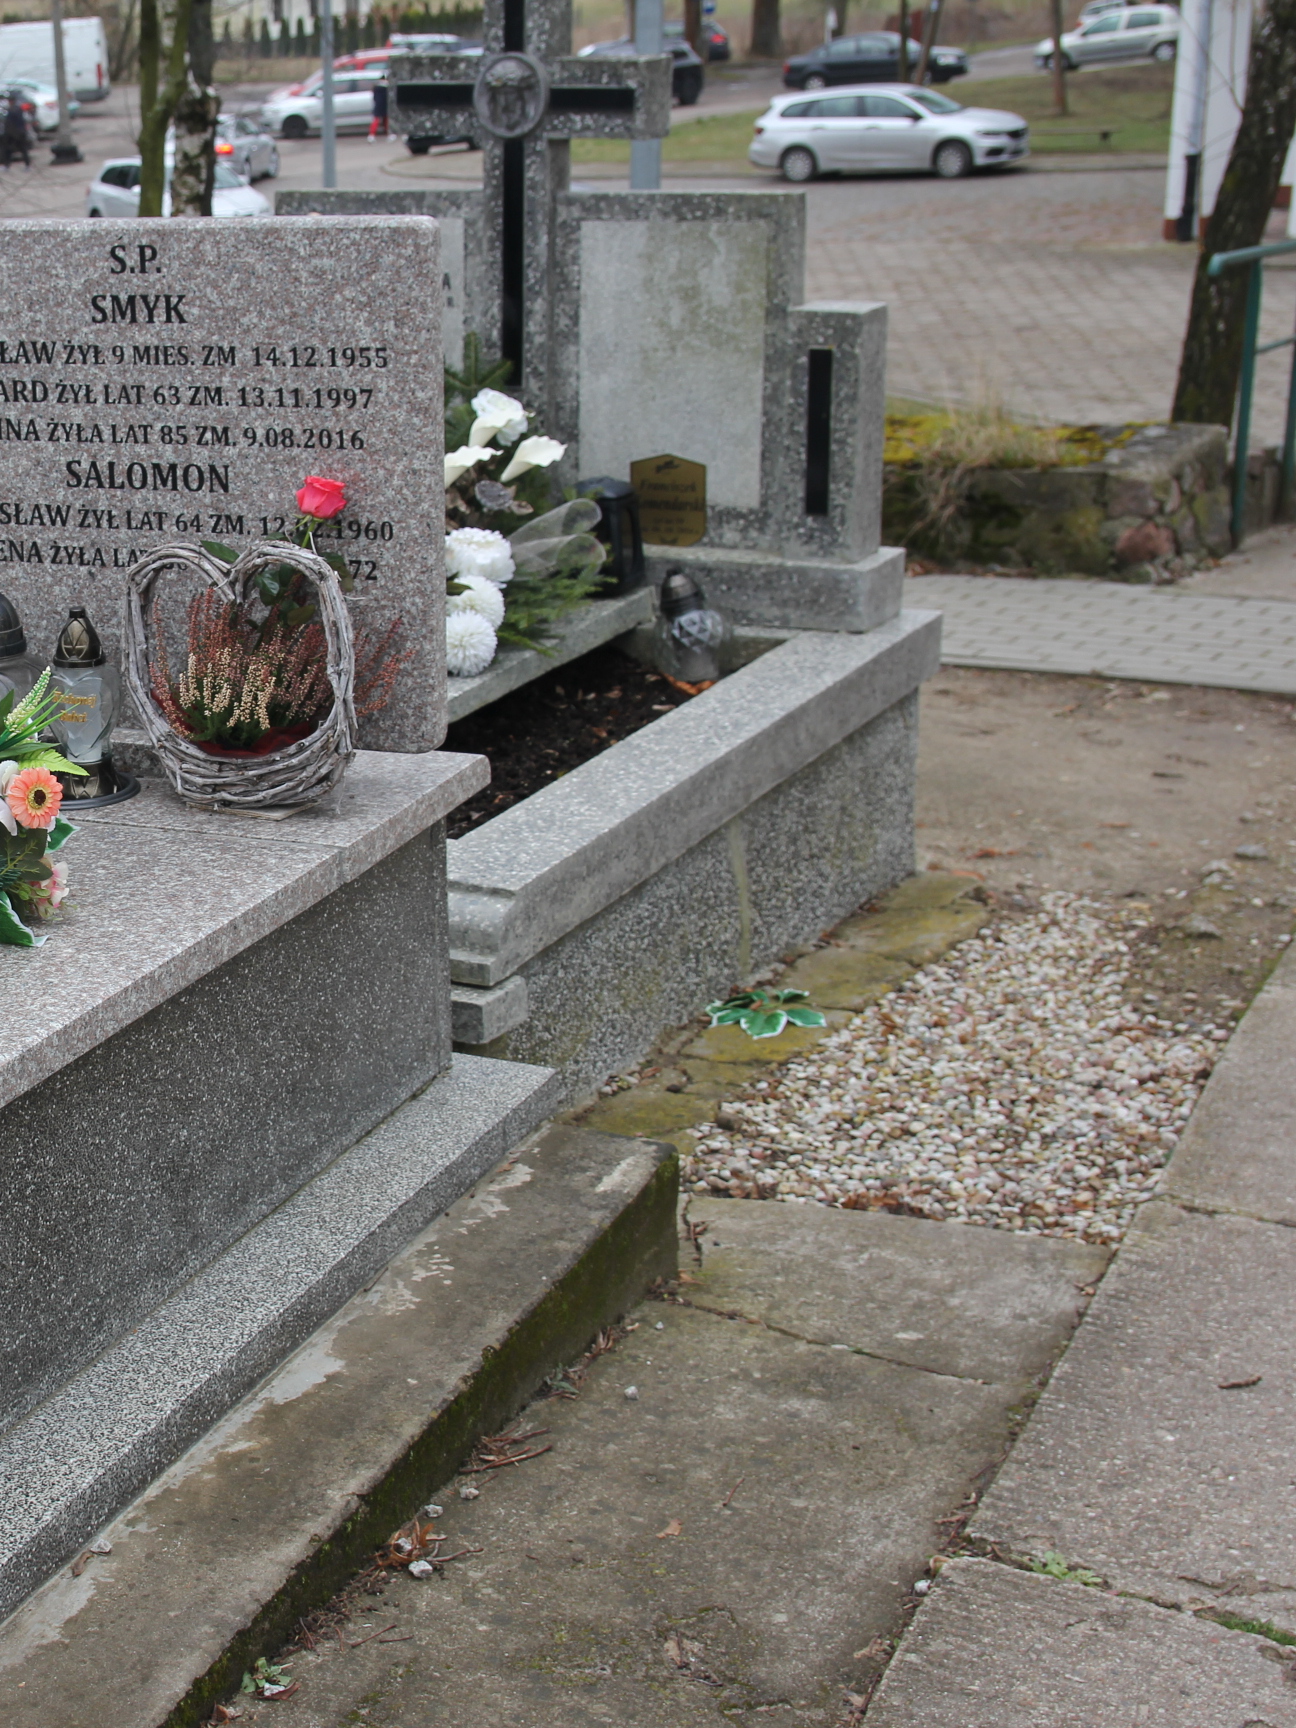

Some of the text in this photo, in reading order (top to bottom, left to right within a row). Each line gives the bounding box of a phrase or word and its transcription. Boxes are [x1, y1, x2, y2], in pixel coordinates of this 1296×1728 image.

[90, 293, 188, 325] SMYK
[63, 339, 106, 365] ŻYŁ
[112, 345, 125, 364] 9
[132, 345, 196, 366] MIES.
[202, 345, 236, 366] ZM
[251, 346, 389, 368] 14.12.1955
[55, 379, 97, 404] ŻYŁ
[104, 384, 146, 405] LAT
[154, 385, 181, 405] 63
[188, 386, 230, 407] ZM.
[237, 387, 374, 409] 13.11.1997
[47, 418, 104, 443] ŻYŁA
[111, 423, 153, 444] LAT
[160, 425, 188, 445] 85
[195, 426, 237, 447] ZM.
[243, 427, 365, 450] 9.08.2016
[65, 459, 230, 493] SALOMON
[78, 504, 120, 530] ŻYŁ
[126, 509, 168, 531] LAT
[175, 513, 204, 533] 64
[209, 514, 251, 535] ZM.
[50, 541, 107, 568] ŻYŁA
